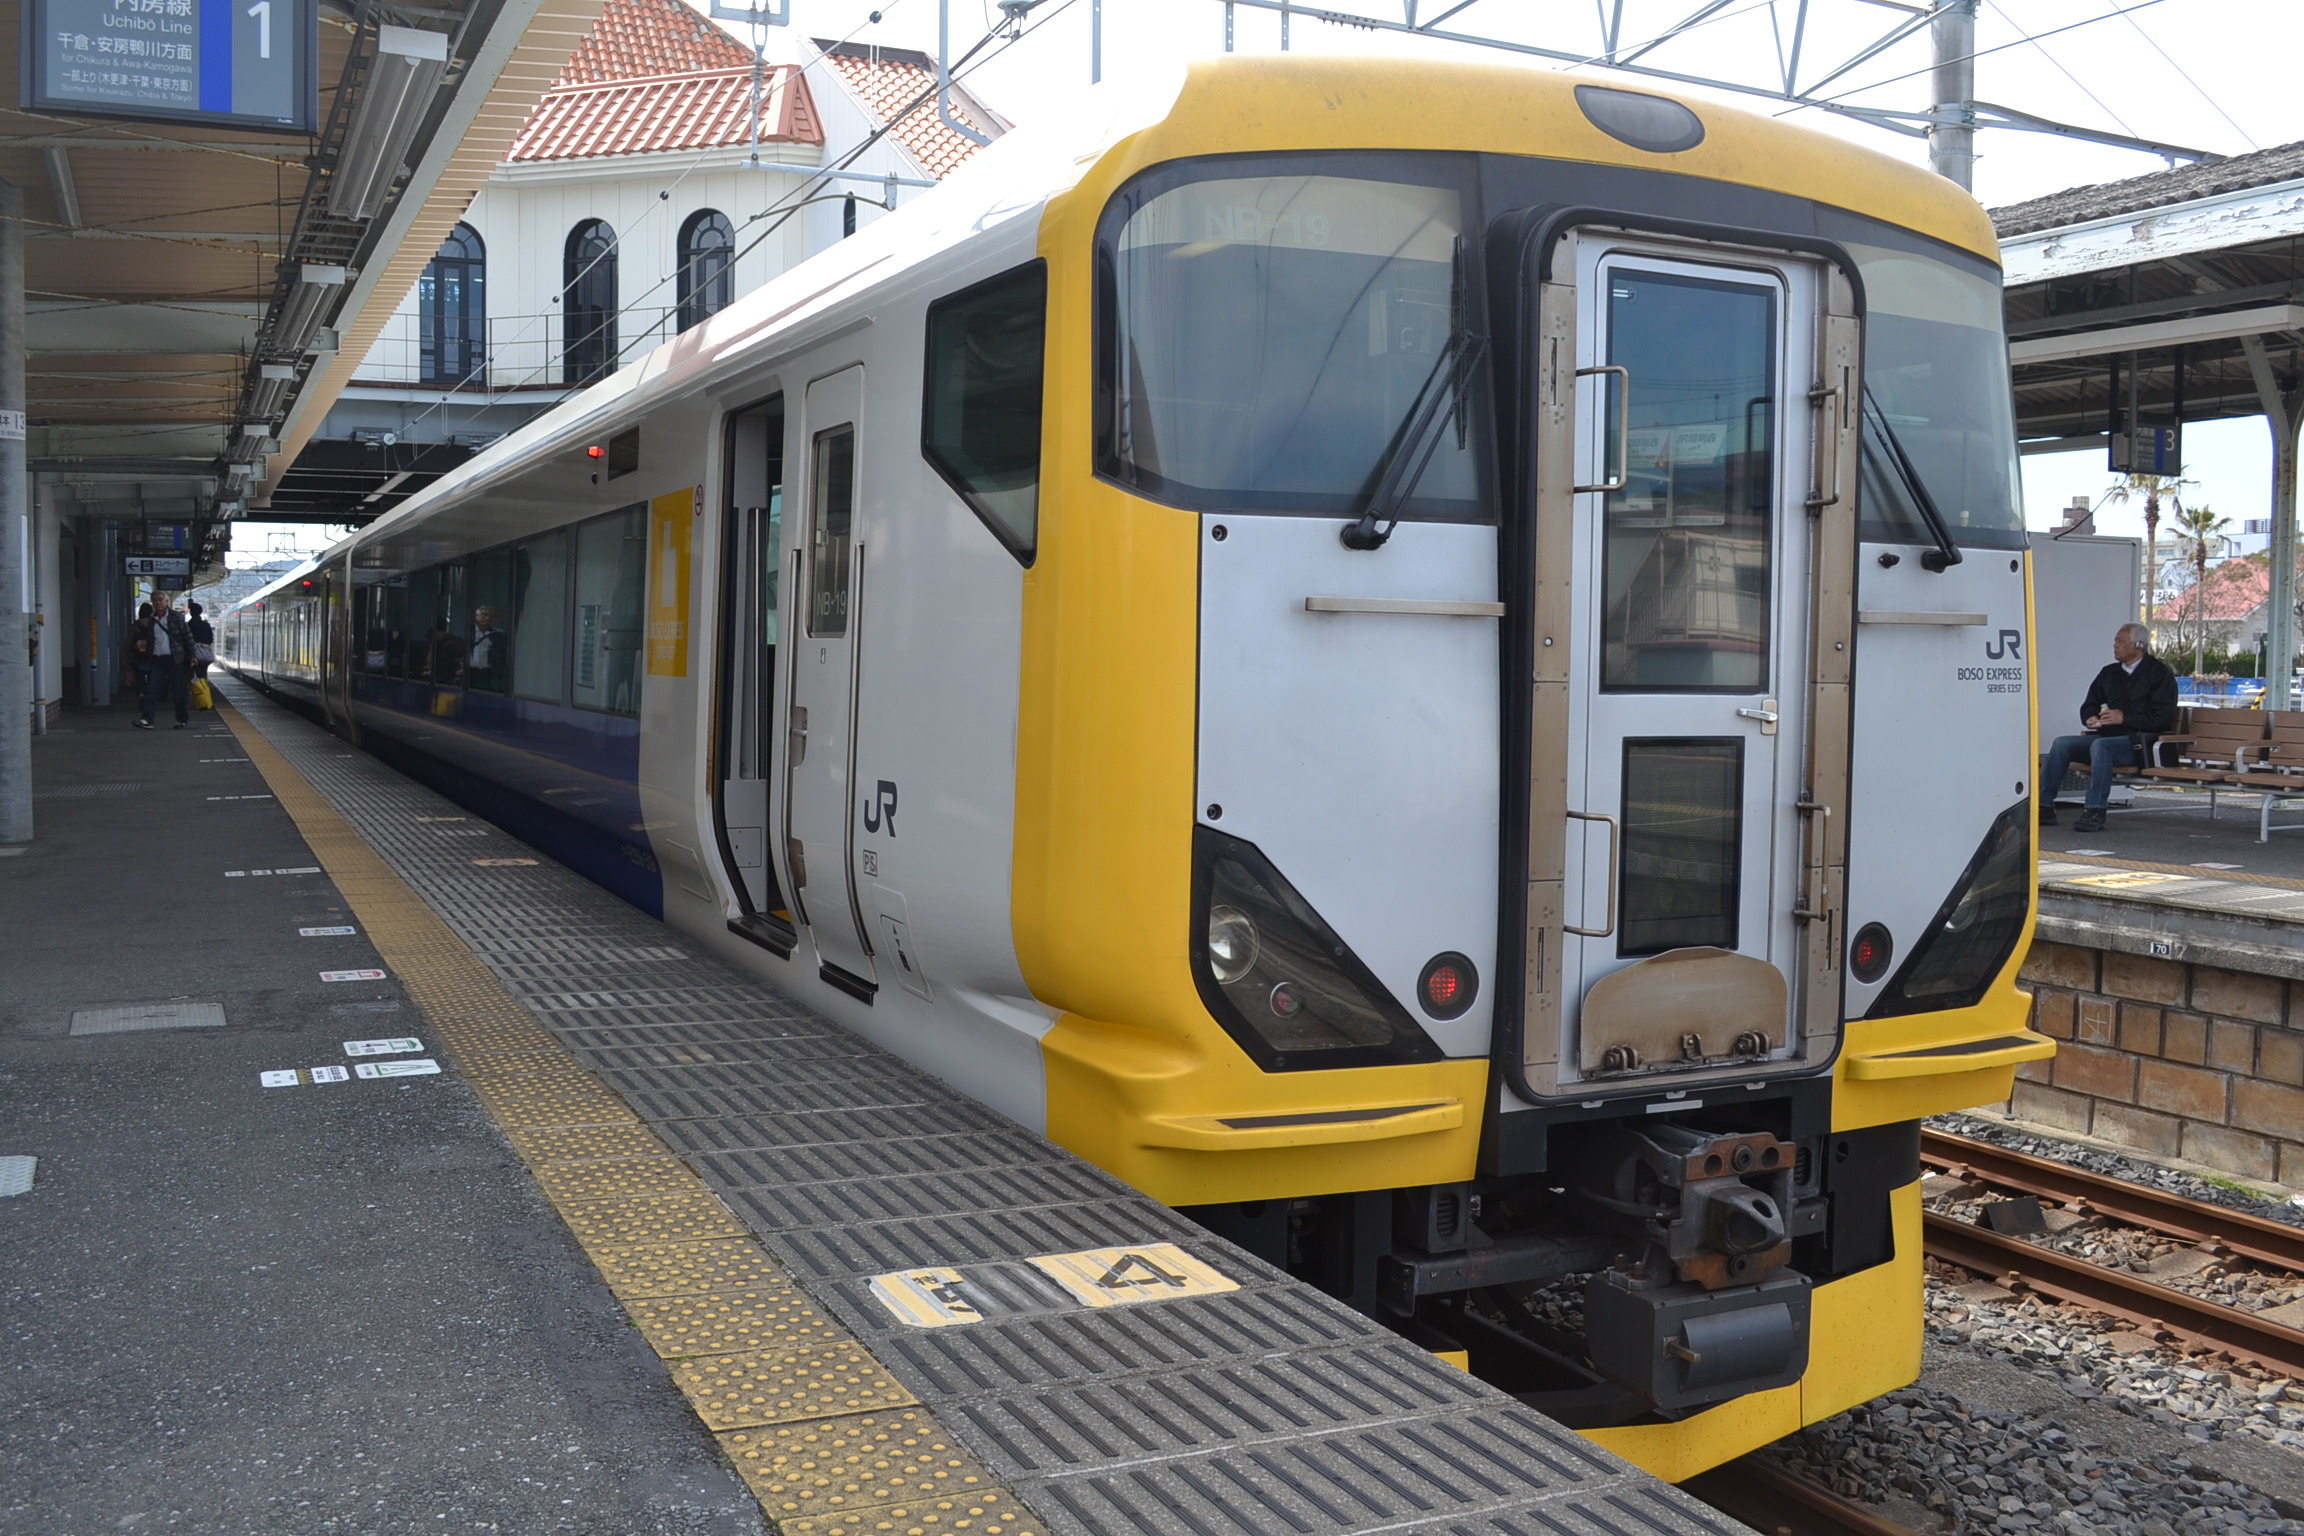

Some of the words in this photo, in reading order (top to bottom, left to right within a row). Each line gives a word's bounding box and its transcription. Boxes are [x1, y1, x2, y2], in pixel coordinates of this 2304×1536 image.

[161, 19, 193, 35] Line
[247, 1, 270, 59] 1
[57, 32, 193, 61] 千倉・安房鴨川方面
[62, 53, 74, 63] for
[76, 54, 110, 67] Chikura
[112, 57, 120, 67] &
[121, 58, 193, 74] Awa-Kamogawa
[1203, 204, 1331, 247] NB-19
[2164, 428, 2176, 452] 3
[183, 527, 190, 539] 1
[816, 589, 847, 616] NB-19
[1985, 628, 2022, 660] JR
[1957, 667, 1984, 681] BOSO
[1986, 667, 2022, 681] EXPRESS
[1987, 683, 2006, 693] SERIES
[2007, 683, 2022, 693] E257
[863, 779, 898, 838] JR
[2155, 944, 2167, 955] 70
[1094, 1253, 1188, 1288] 4
